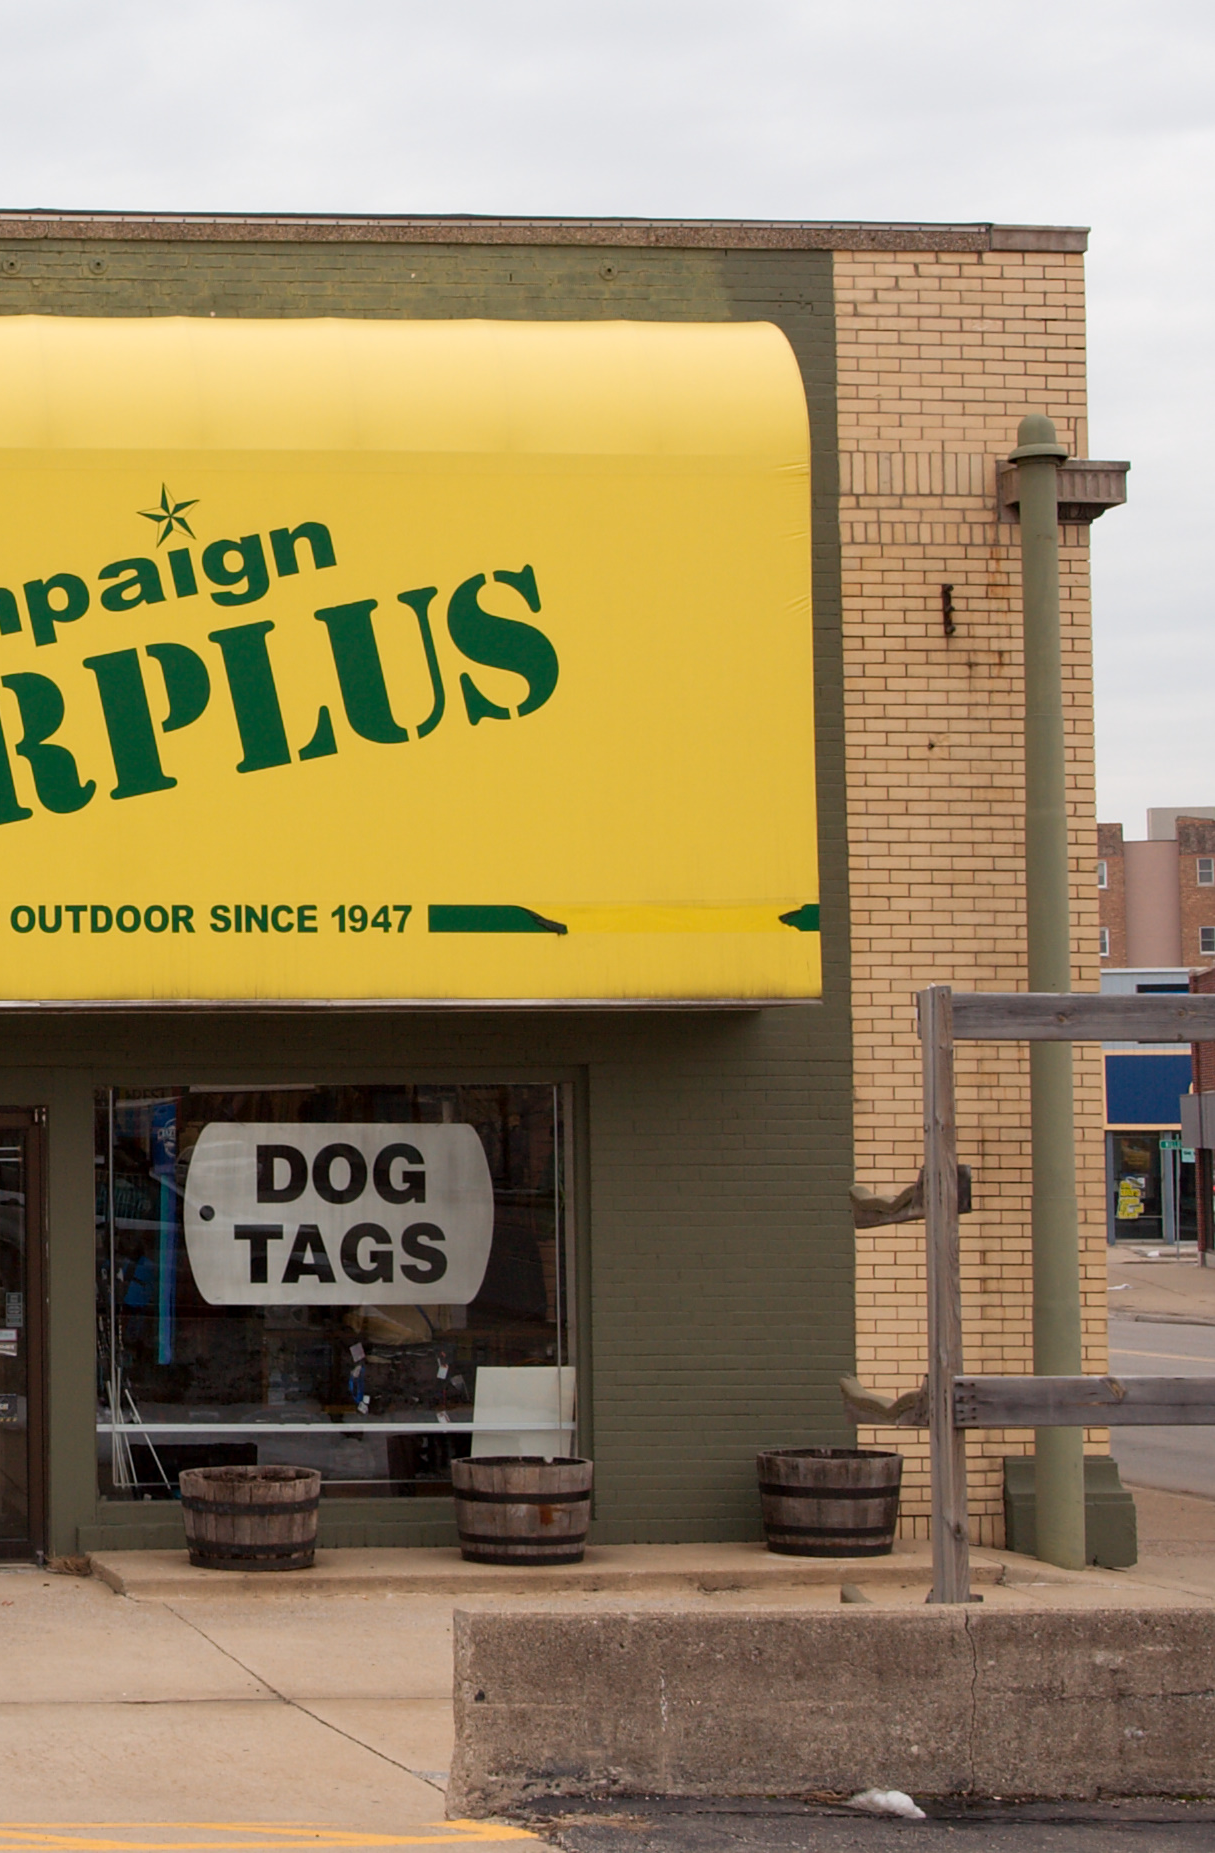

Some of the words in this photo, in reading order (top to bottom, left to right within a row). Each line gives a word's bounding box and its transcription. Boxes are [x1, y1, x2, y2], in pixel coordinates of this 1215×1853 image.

[10, 904, 196, 934] OUTDOOR
[209, 904, 318, 933] SINCE
[331, 904, 413, 933] 1947
[256, 1142, 427, 1205] DOG
[233, 1221, 448, 1285] TAGS
